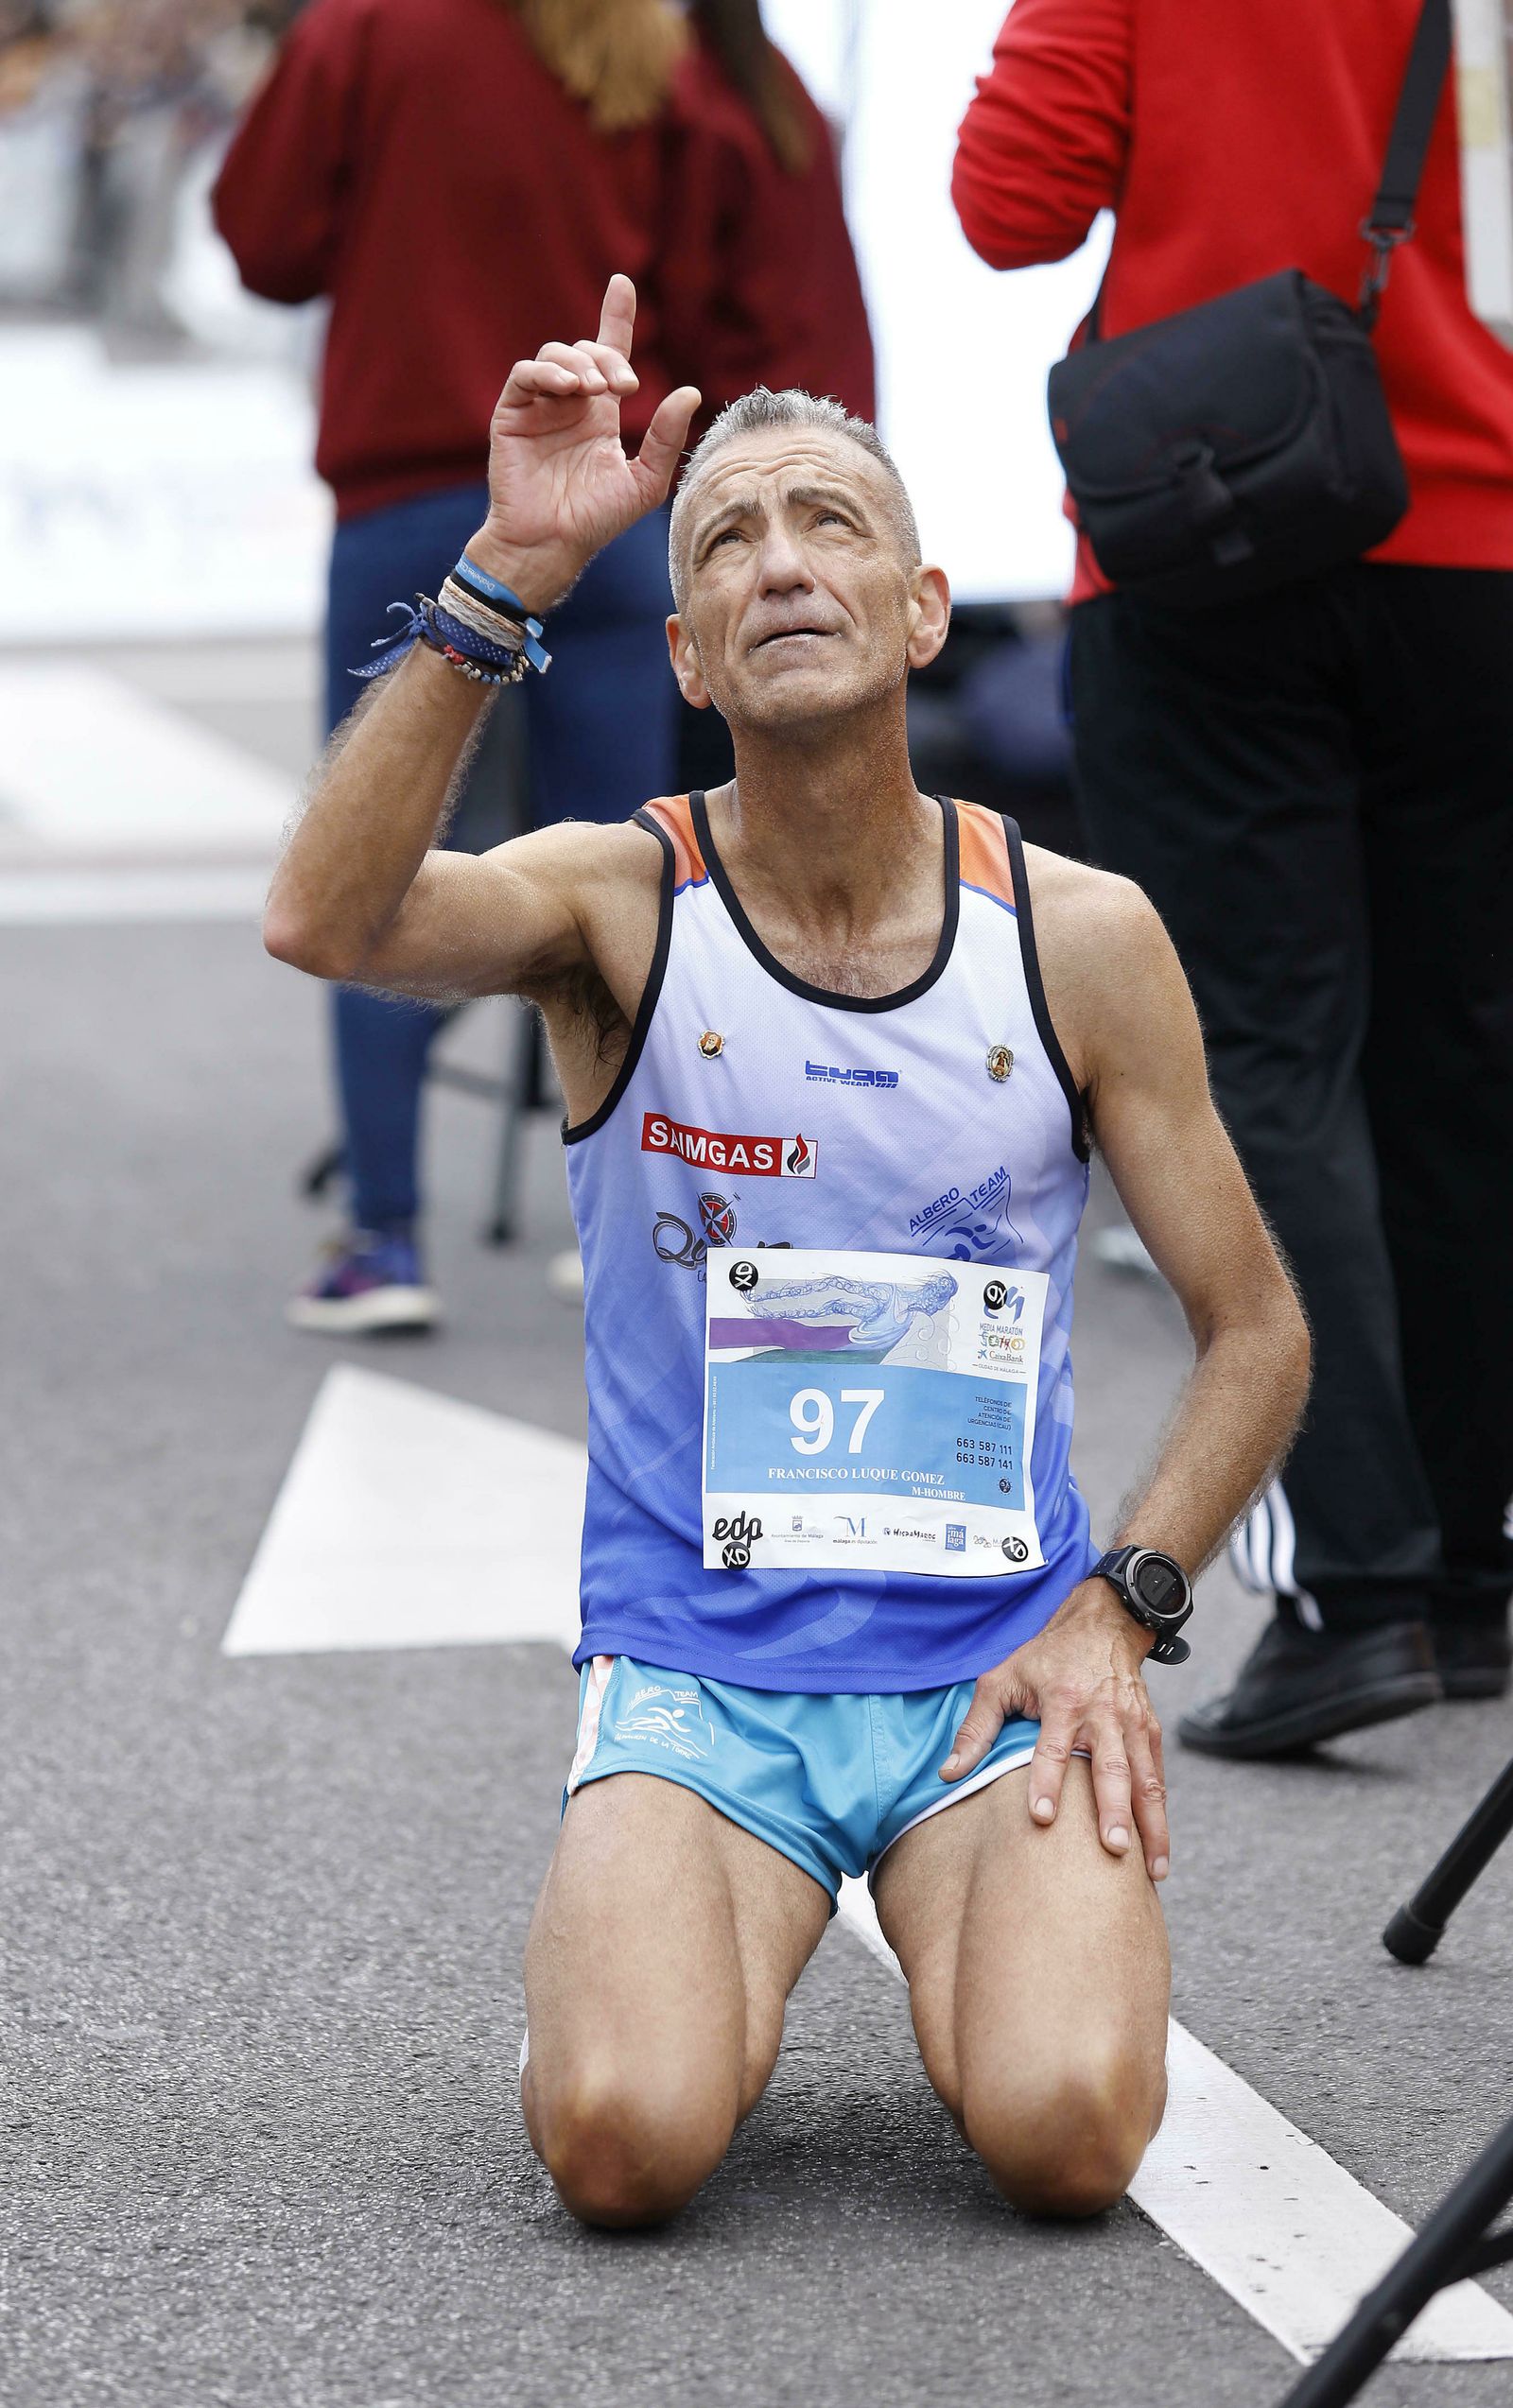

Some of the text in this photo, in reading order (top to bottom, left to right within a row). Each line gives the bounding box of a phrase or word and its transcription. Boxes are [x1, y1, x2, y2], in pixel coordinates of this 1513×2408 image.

[649, 1121, 774, 1170] SAIMGAS
[909, 1166, 1006, 1232] ALBERO TEAM
[980, 1323, 1023, 1336] MEDIA MARATÓN
[789, 1388, 885, 1455] 97
[967, 1418, 997, 1428] URGENCIAS
[957, 1437, 1012, 1455] 663 587 111
[957, 1452, 1012, 1469] 663 587 141
[768, 1467, 945, 1485] FRANCISCO LUQUE GOMEZ
[912, 1486, 965, 1501] M-HOMBRE
[711, 1510, 764, 1549] edp
